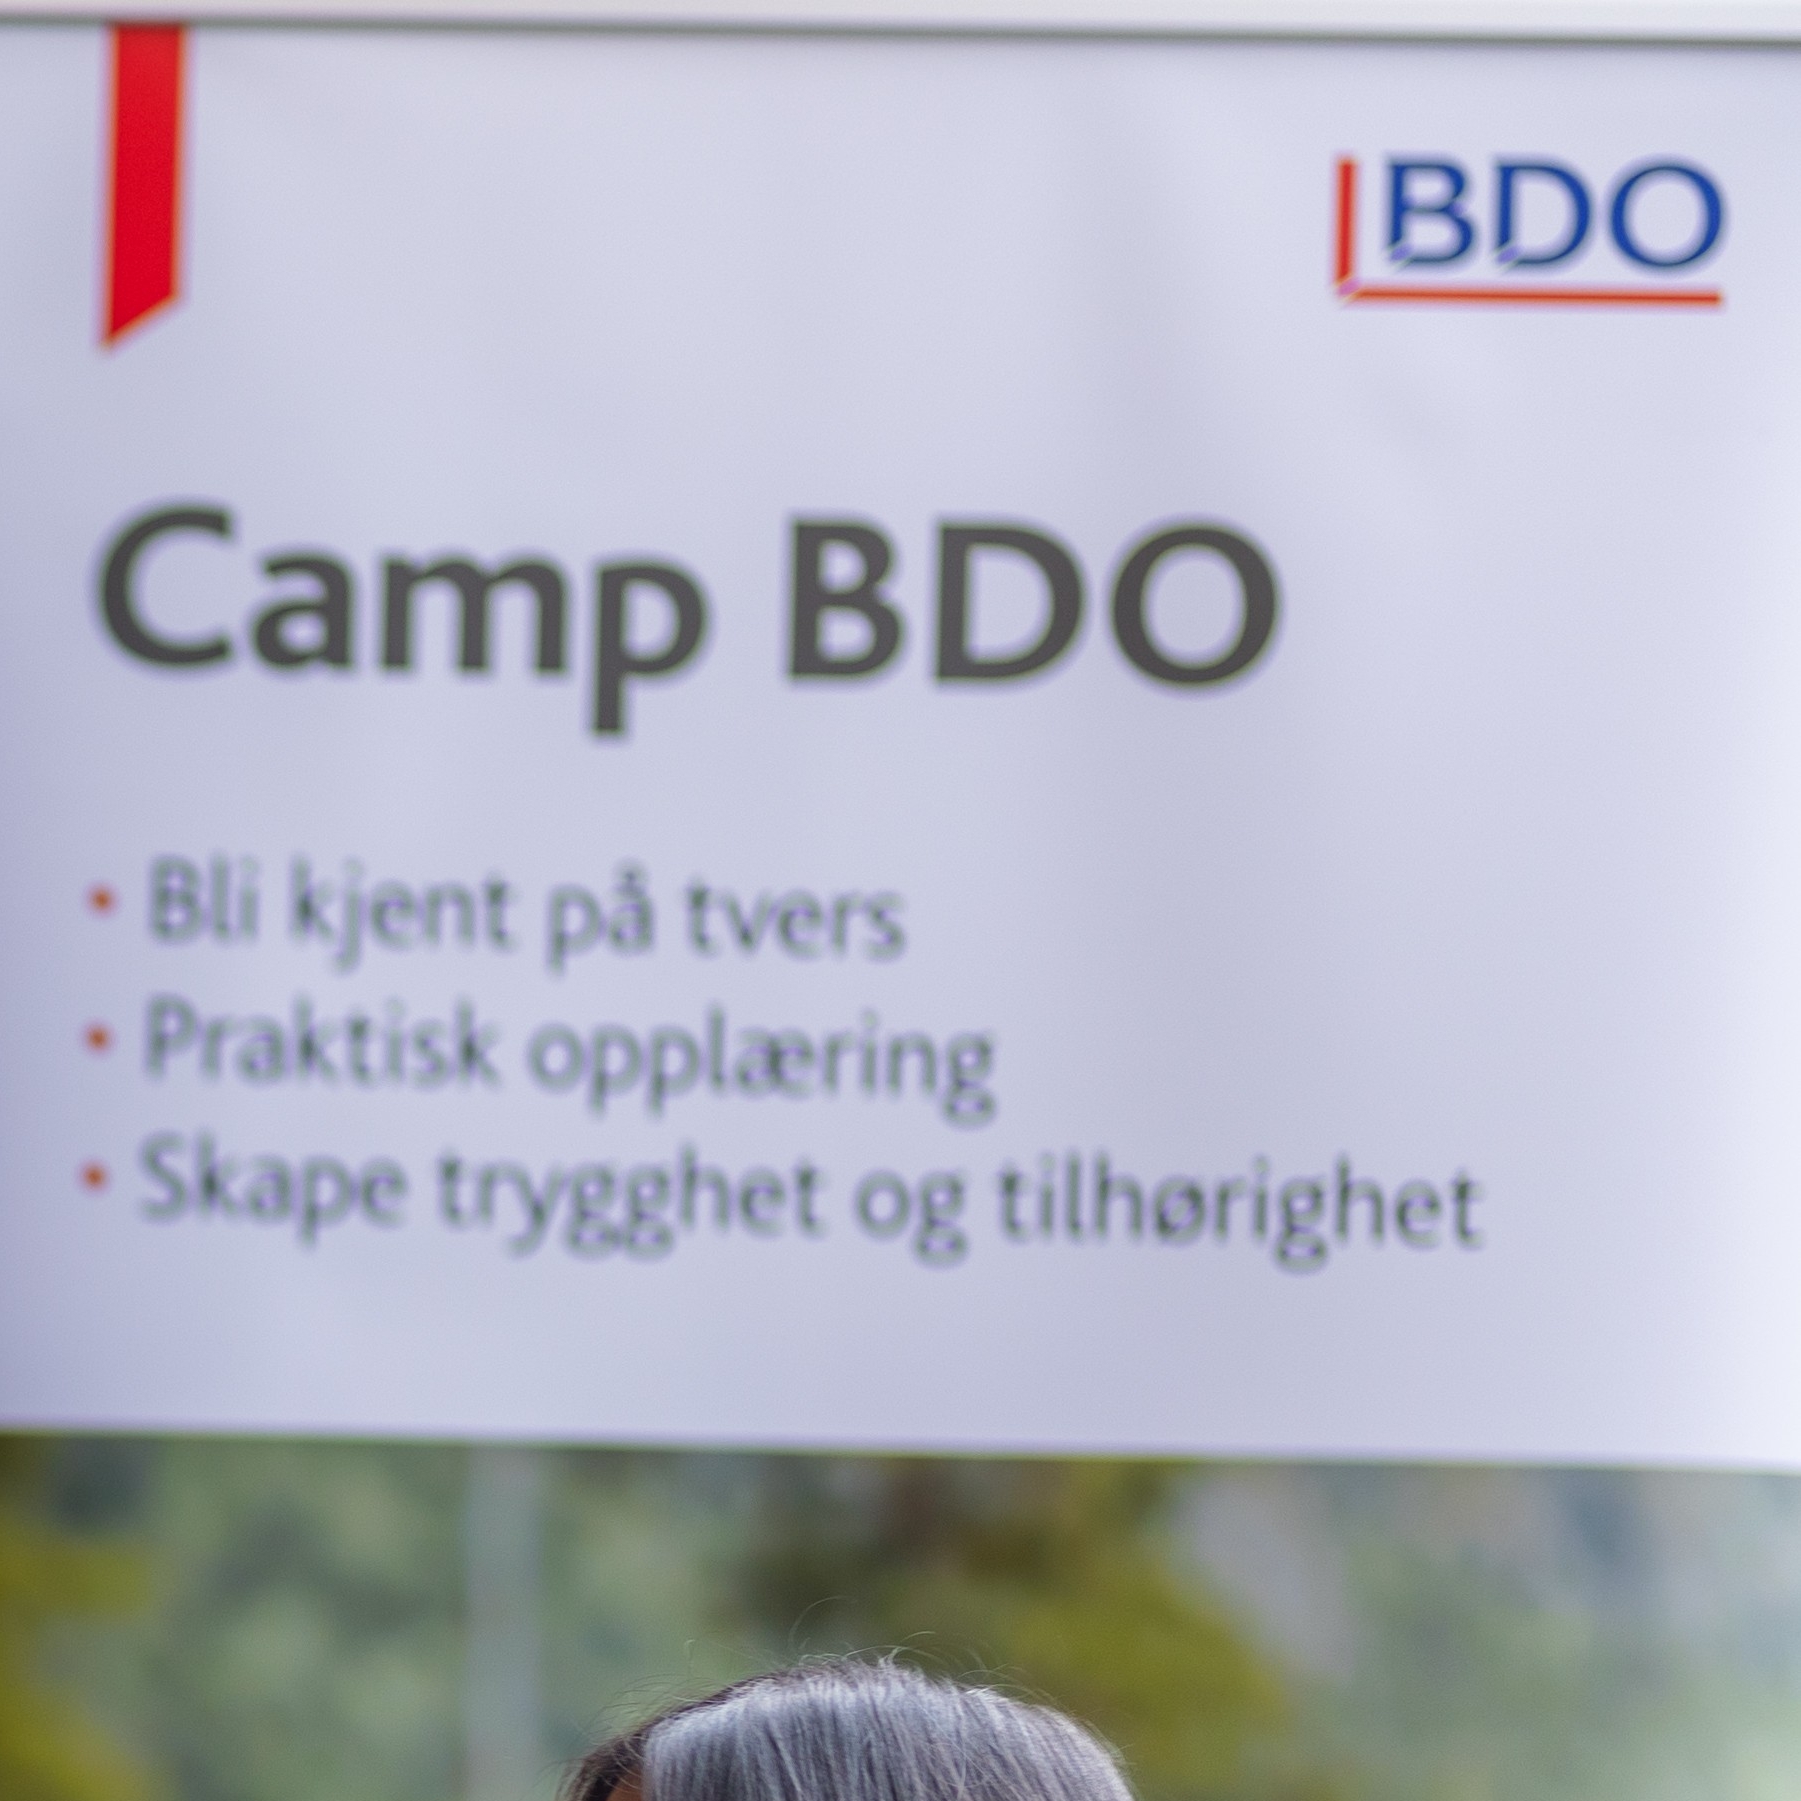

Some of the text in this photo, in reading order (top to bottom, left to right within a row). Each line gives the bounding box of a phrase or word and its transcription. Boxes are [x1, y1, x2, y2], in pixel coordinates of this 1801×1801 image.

[1385, 156, 1726, 274] BDO
[93, 501, 1283, 741] Camp BDO
[146, 853, 907, 977] Bli kjent på tvers
[143, 992, 998, 1131] Praktisk opplæring
[138, 1130, 1483, 1276] Skape trygghet og tilhørighet
